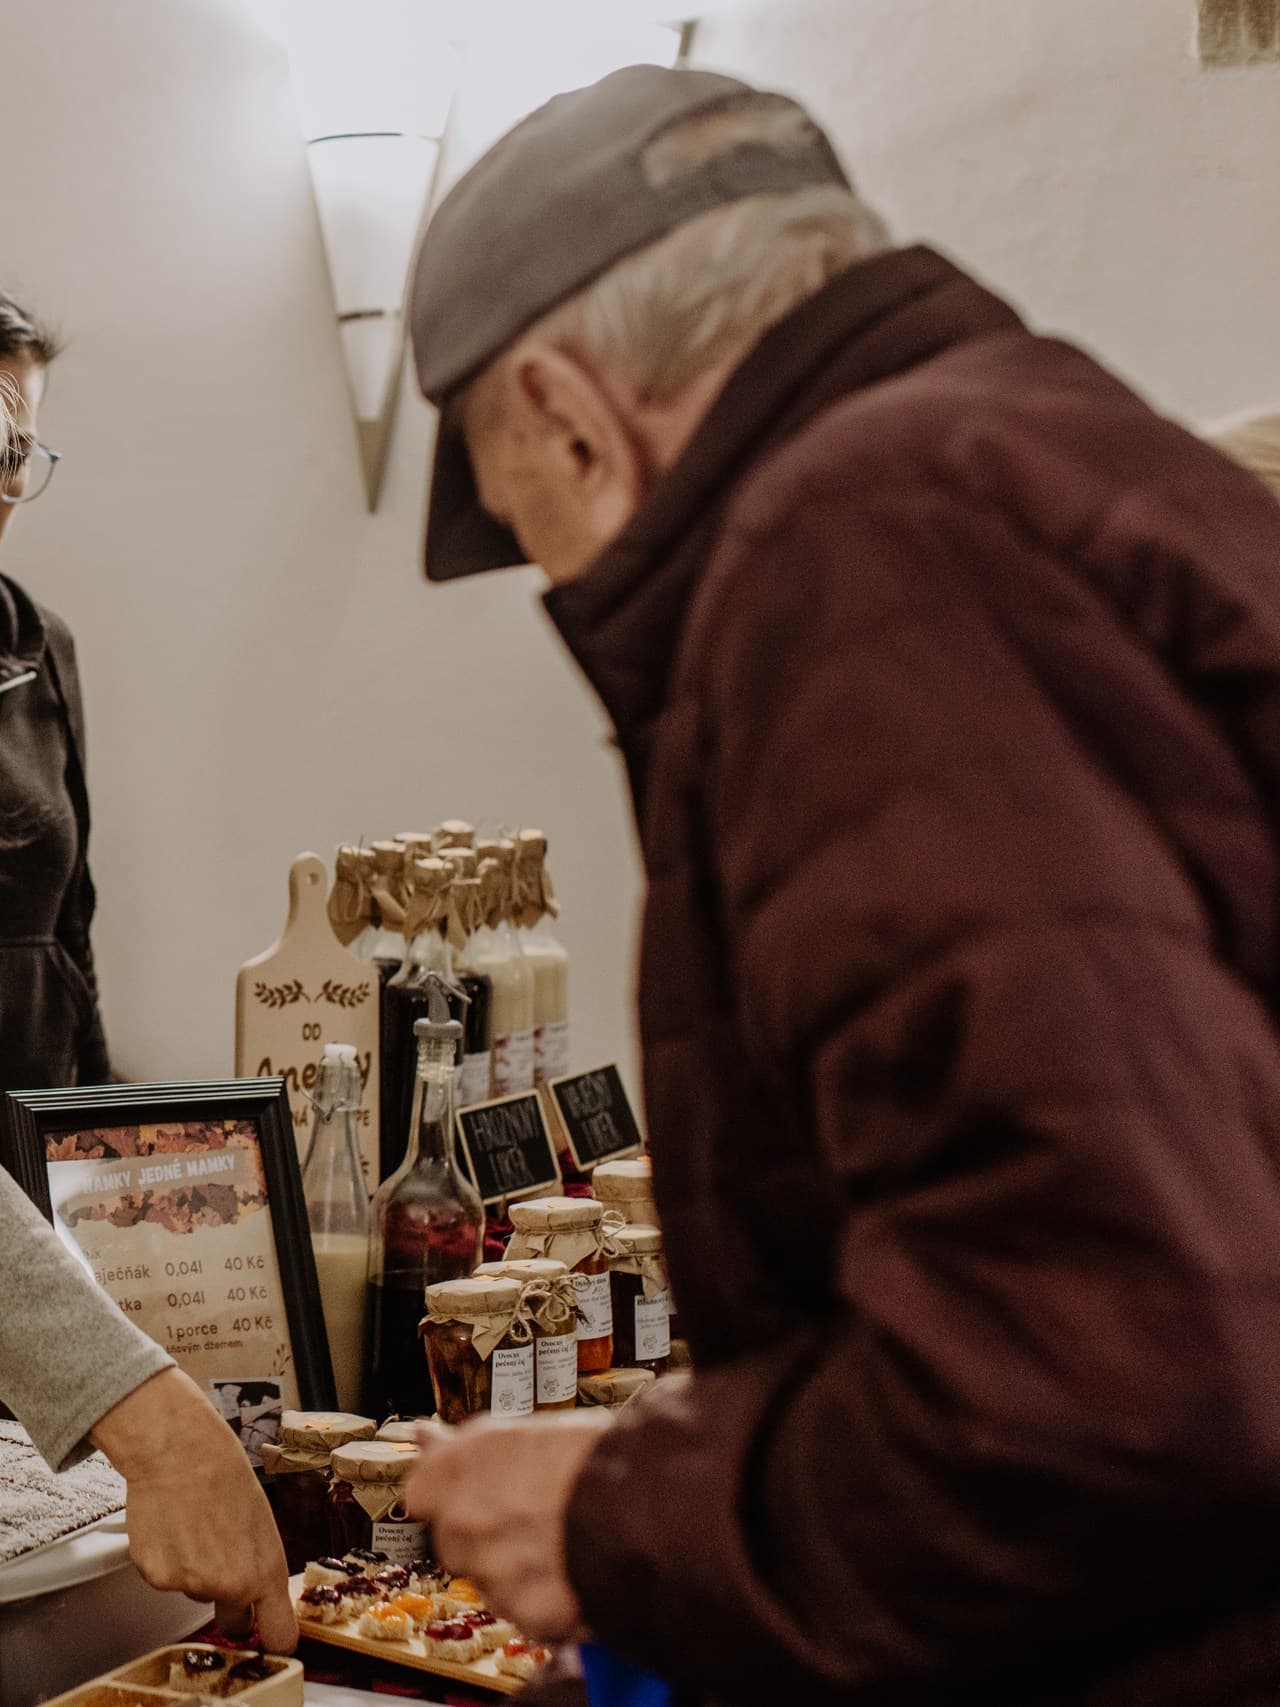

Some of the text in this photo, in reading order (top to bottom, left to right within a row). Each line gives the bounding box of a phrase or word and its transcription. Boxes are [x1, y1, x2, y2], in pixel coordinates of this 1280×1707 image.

[138, 1158, 182, 1186] JEDNÉ
[94, 1255, 265, 1286] aječňák 0,04l 40 Kč
[167, 1290, 205, 1309] 0,04l
[227, 1287, 246, 1301] 40
[249, 1284, 268, 1300] Kč
[176, 1324, 218, 1342] porce
[233, 1317, 251, 1332] 40
[255, 1316, 273, 1330] Kč
